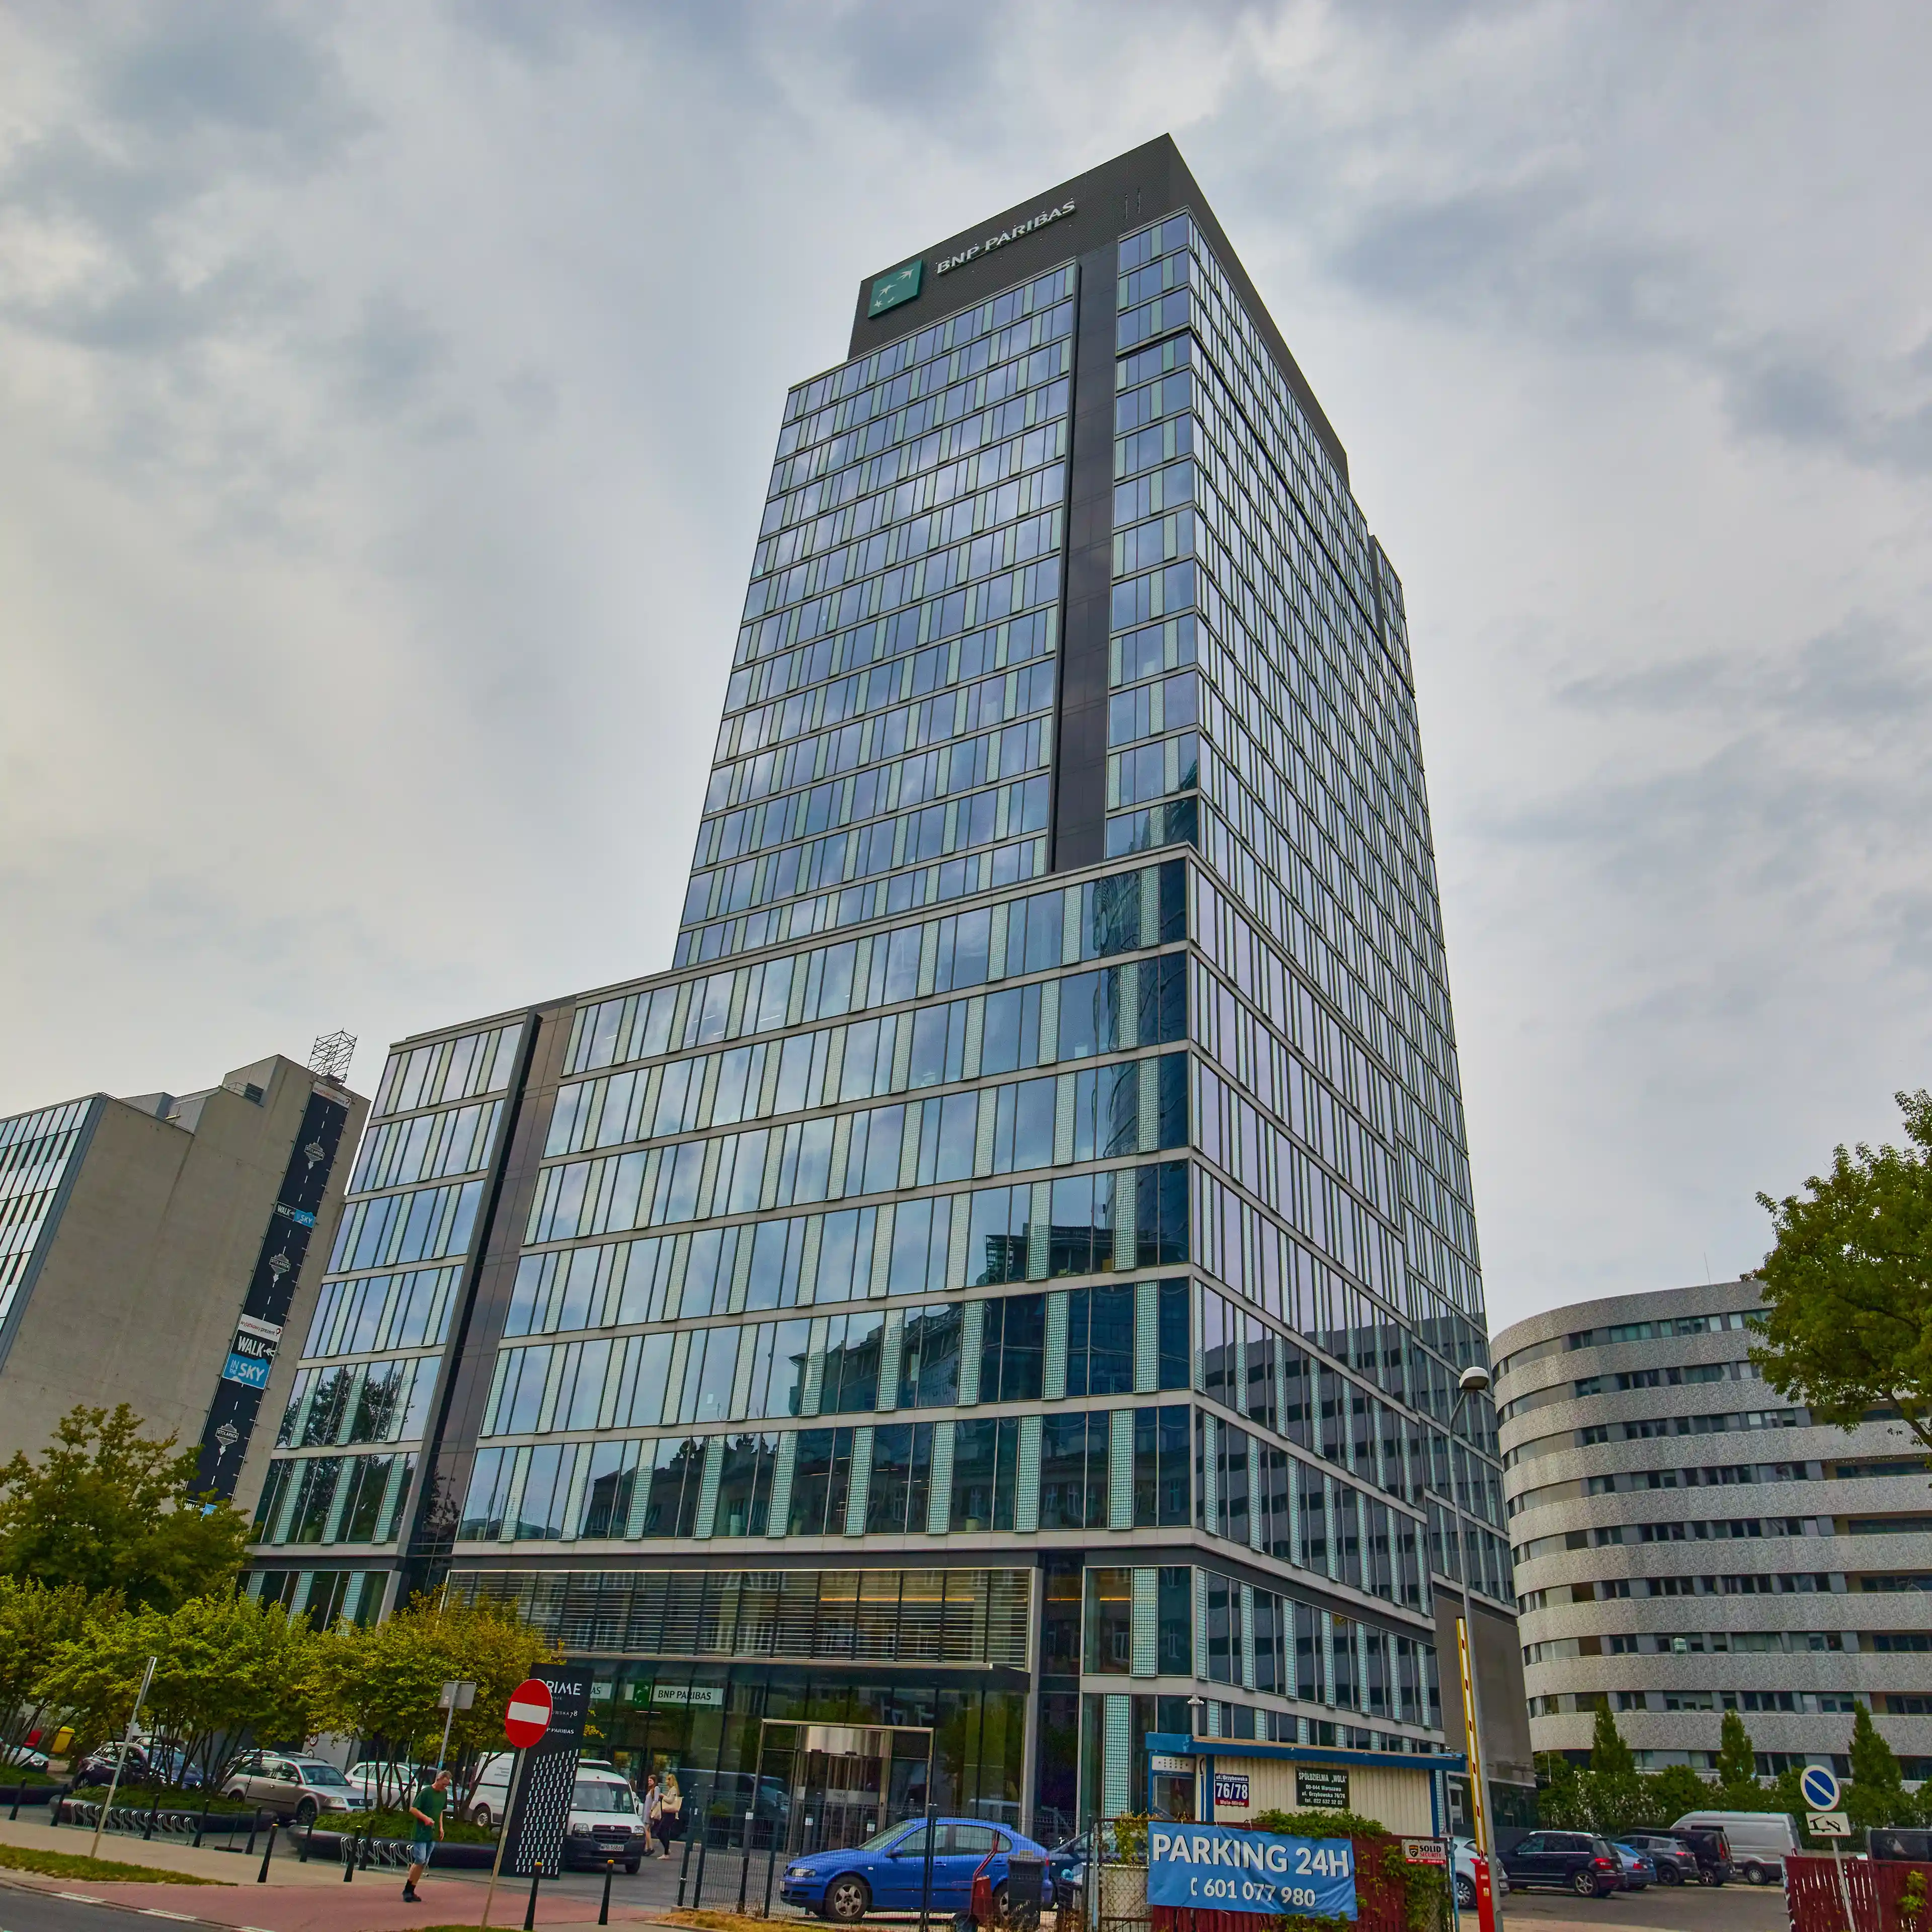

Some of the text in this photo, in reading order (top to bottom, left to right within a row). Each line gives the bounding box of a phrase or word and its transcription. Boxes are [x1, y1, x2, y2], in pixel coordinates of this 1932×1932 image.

[937, 201, 1076, 274] BNP PARIBAS
[278, 1205, 291, 1216] WALK
[300, 1215, 312, 1224] SKY
[237, 1336, 265, 1357] WALK
[230, 1359, 239, 1370] IN
[238, 1363, 265, 1381] SKY
[546, 1680, 582, 1696] RIME
[658, 1690, 675, 1698] BNP
[1216, 1783, 1248, 1799] 76/78
[1152, 1833, 1349, 1877] PARKING 24H
[1203, 1878, 1316, 1907] 601 077 980
